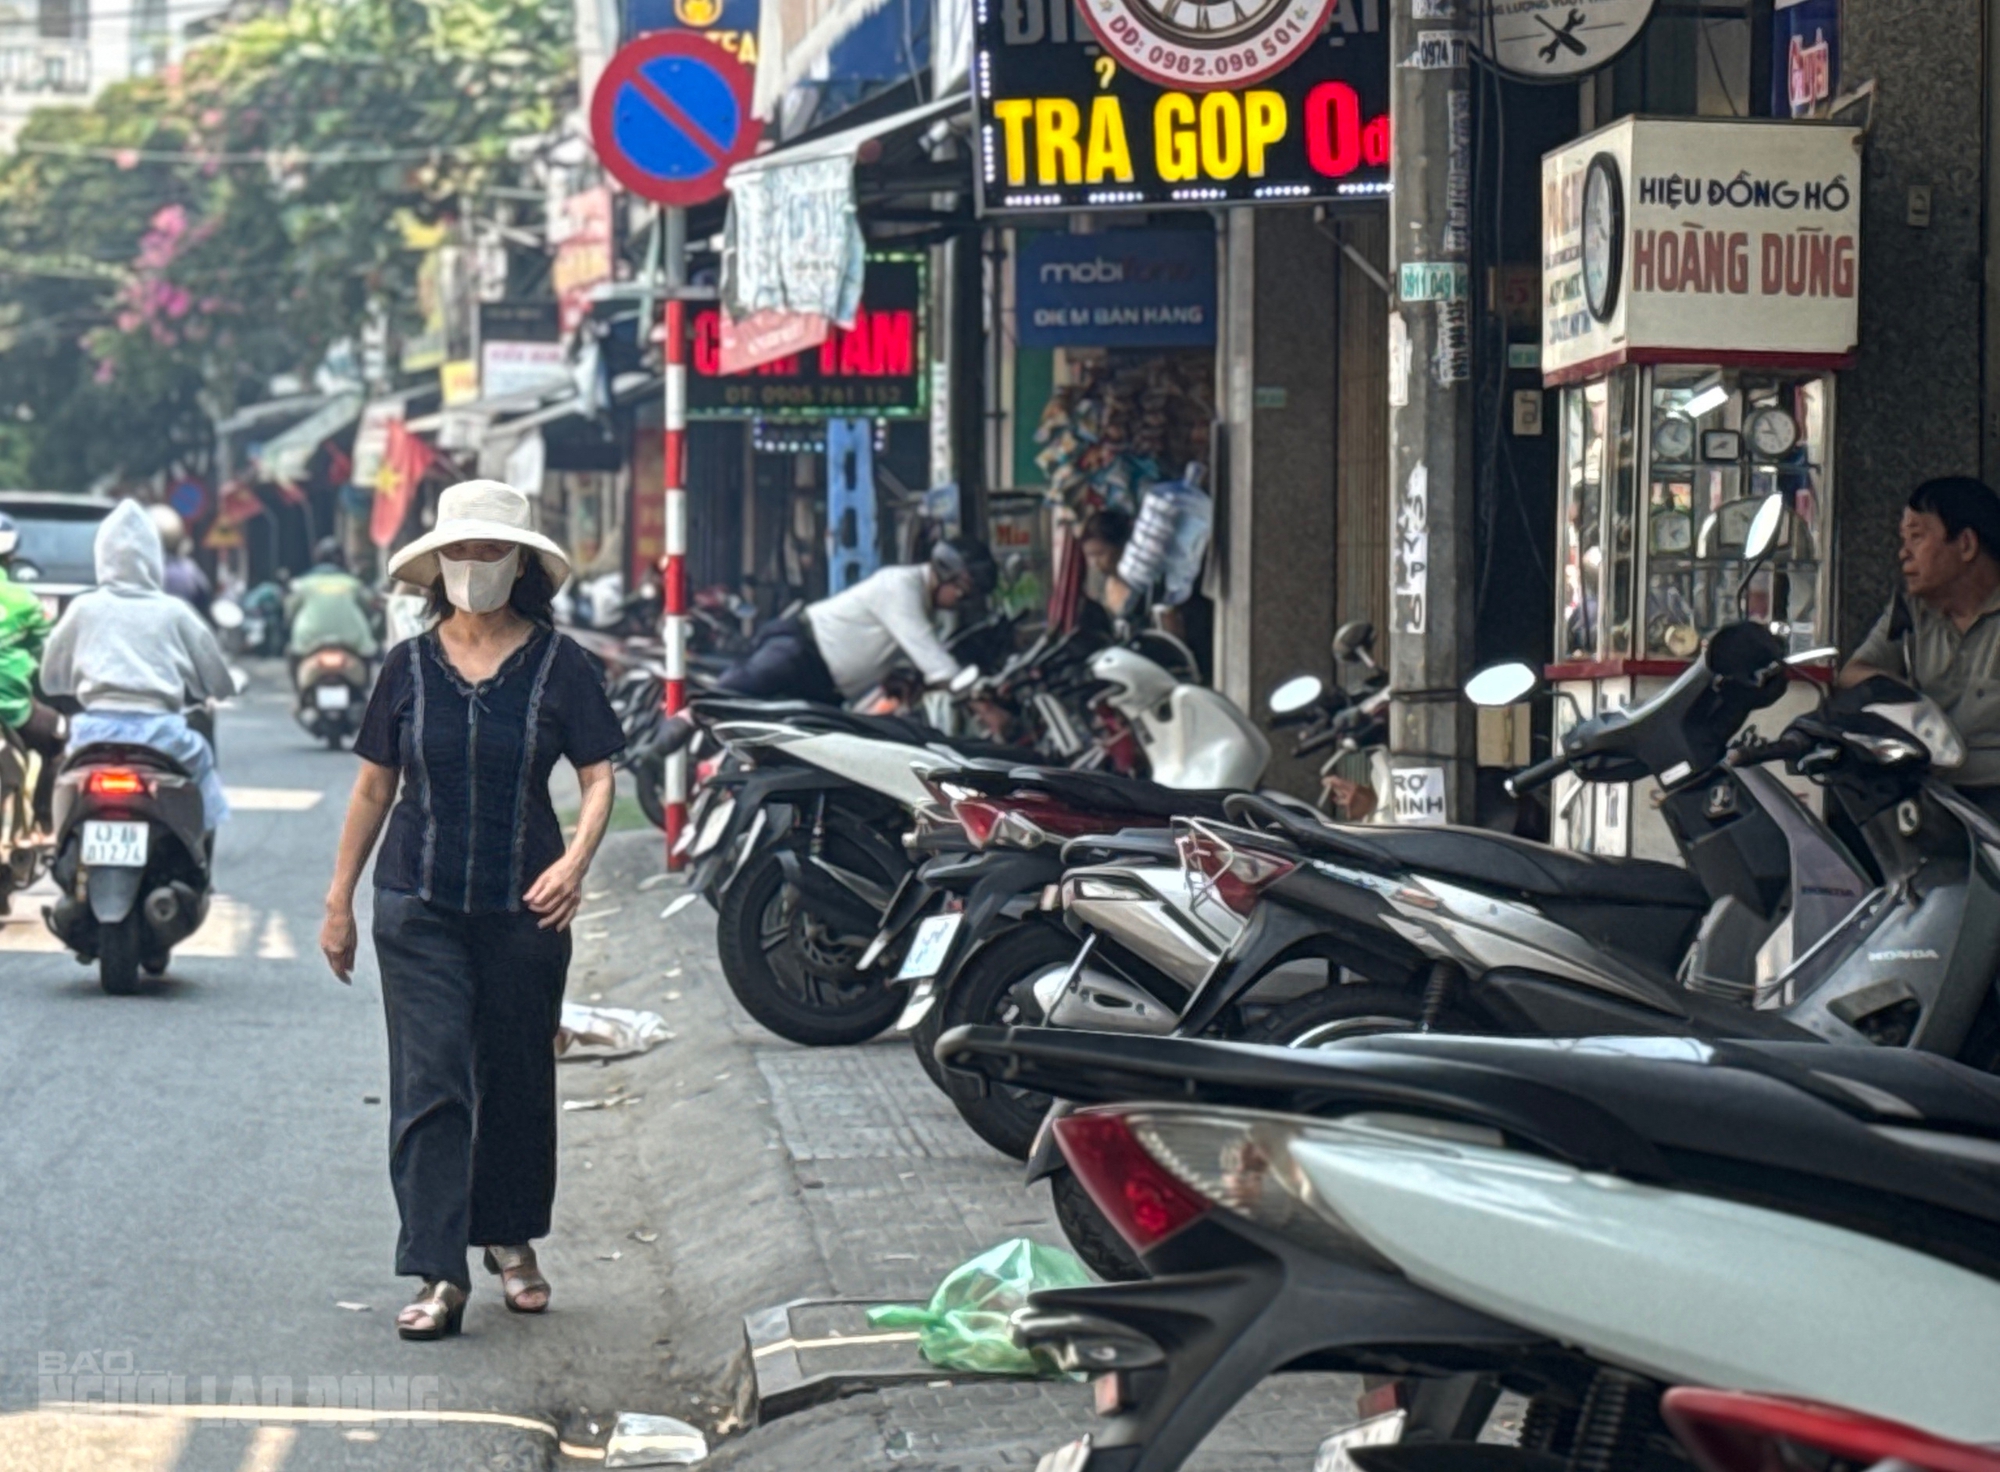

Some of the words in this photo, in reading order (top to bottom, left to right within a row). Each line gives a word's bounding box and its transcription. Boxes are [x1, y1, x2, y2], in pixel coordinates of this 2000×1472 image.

[1148, 45, 1260, 77] 0982.098
[1261, 18, 1302, 57] 501
[994, 56, 1134, 187] TRẢ
[1640, 173, 1701, 209] HIỆU
[1707, 169, 1800, 209] ĐỒNG
[1804, 174, 1850, 211] HỒ
[1633, 221, 1749, 295] HOÀNG
